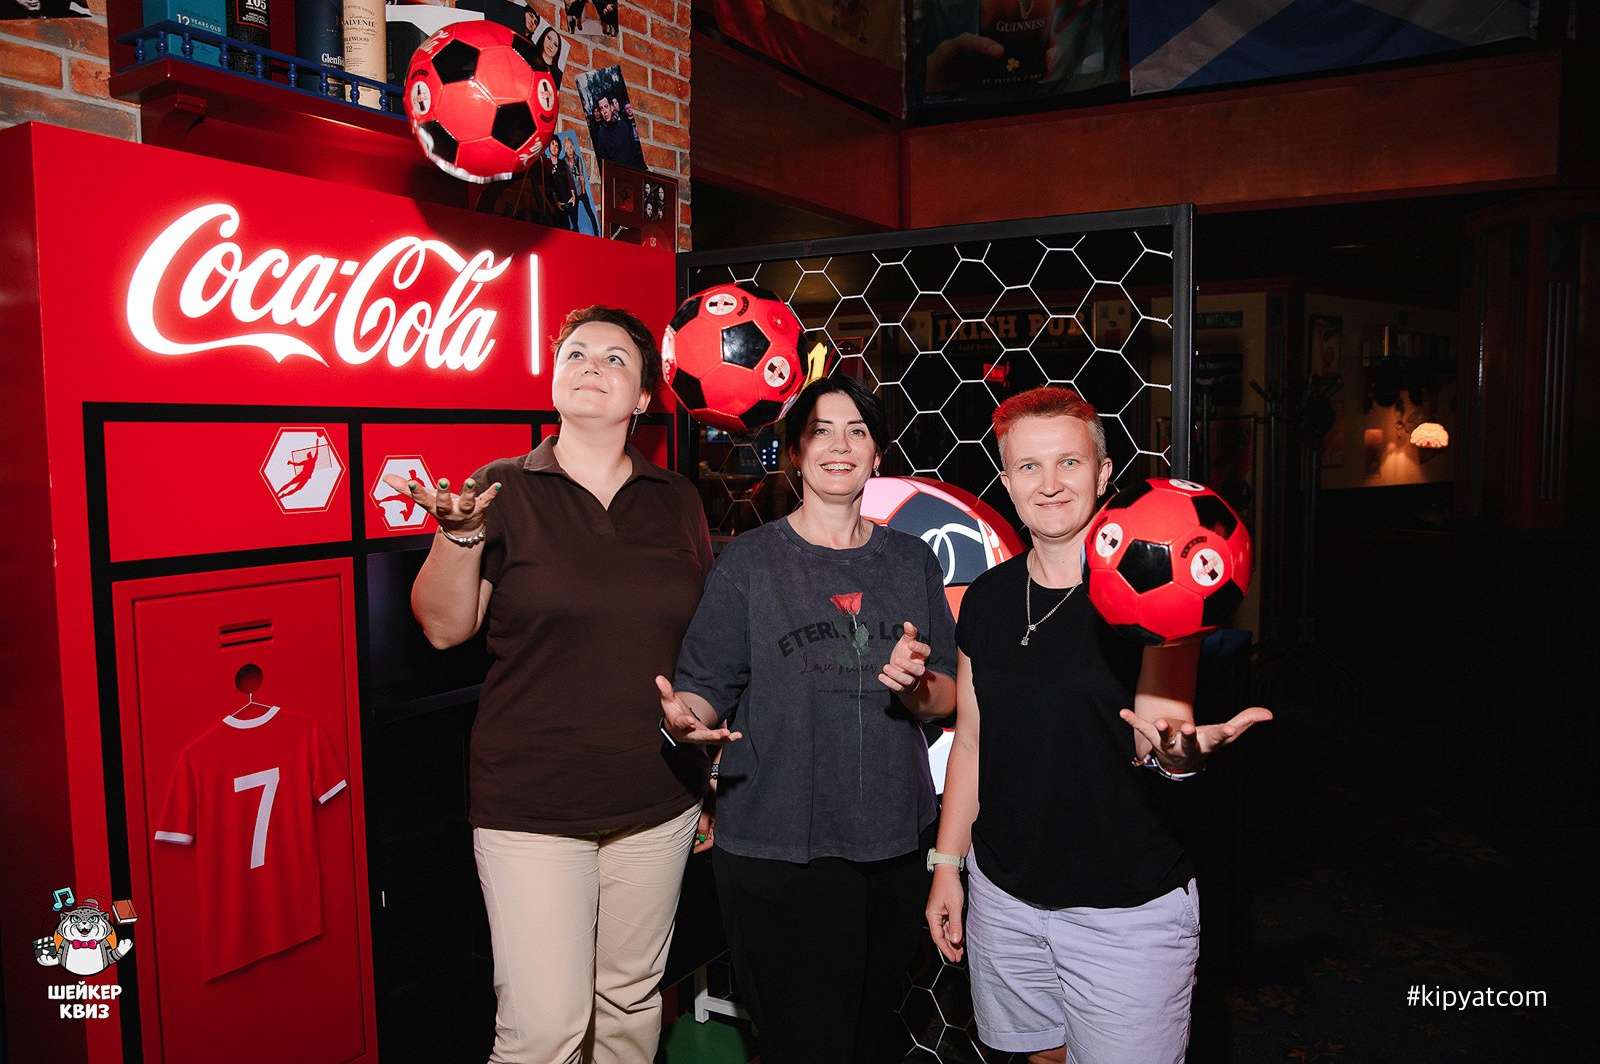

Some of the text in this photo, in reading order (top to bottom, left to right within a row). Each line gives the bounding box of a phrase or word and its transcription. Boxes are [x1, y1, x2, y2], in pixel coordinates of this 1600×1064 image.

[176, 13, 190, 26] 12
[190, 18, 209, 28] YEARS
[209, 24, 222, 32] OLD
[344, 19, 376, 28] ALVENIE
[995, 19, 1045, 33] GUINNESS
[127, 203, 514, 371] Coca-Cola
[937, 311, 1086, 341] IRISH PUB
[777, 621, 875, 658] ETER
[799, 652, 836, 675] Love
[233, 767, 280, 869] 7
